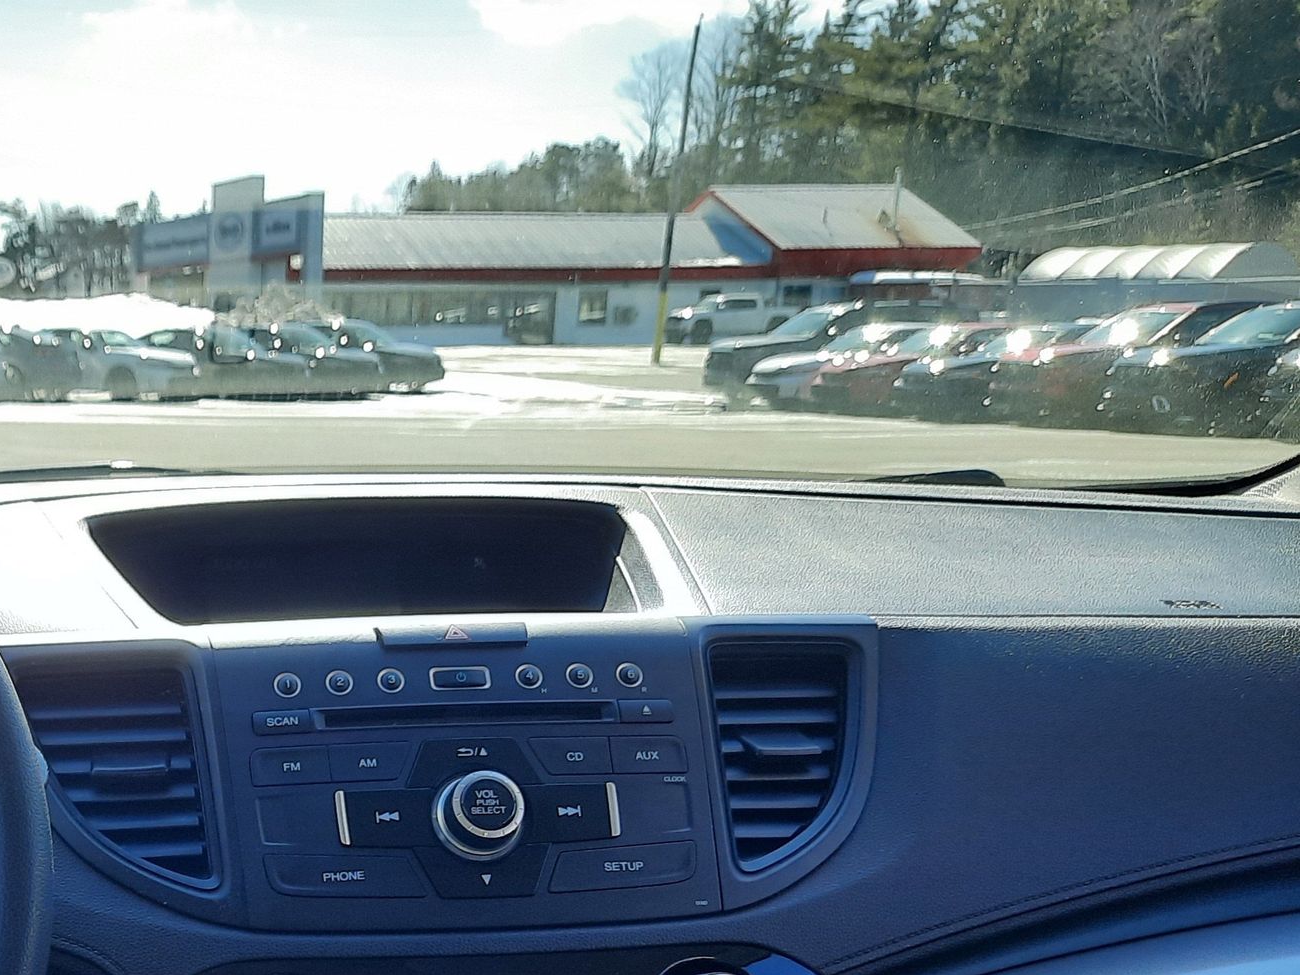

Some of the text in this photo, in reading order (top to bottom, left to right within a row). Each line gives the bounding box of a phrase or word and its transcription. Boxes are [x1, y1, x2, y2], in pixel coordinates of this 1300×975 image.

[387, 674, 396, 685] 3
[525, 670, 534, 681] 4
[576, 669, 586, 680] 5
[626, 669, 636, 680] 6
[284, 679, 291, 689] 1
[335, 676, 345, 687] 2
[266, 716, 299, 727] SCAN
[566, 751, 584, 762] CD
[635, 750, 660, 761] AUX
[283, 762, 302, 772] FM
[358, 758, 378, 769] AM
[475, 789, 499, 799] VOL
[476, 798, 500, 806] PUSH
[470, 806, 506, 815] SELECT
[604, 861, 644, 873] SETUP
[323, 871, 365, 882] PHONE
